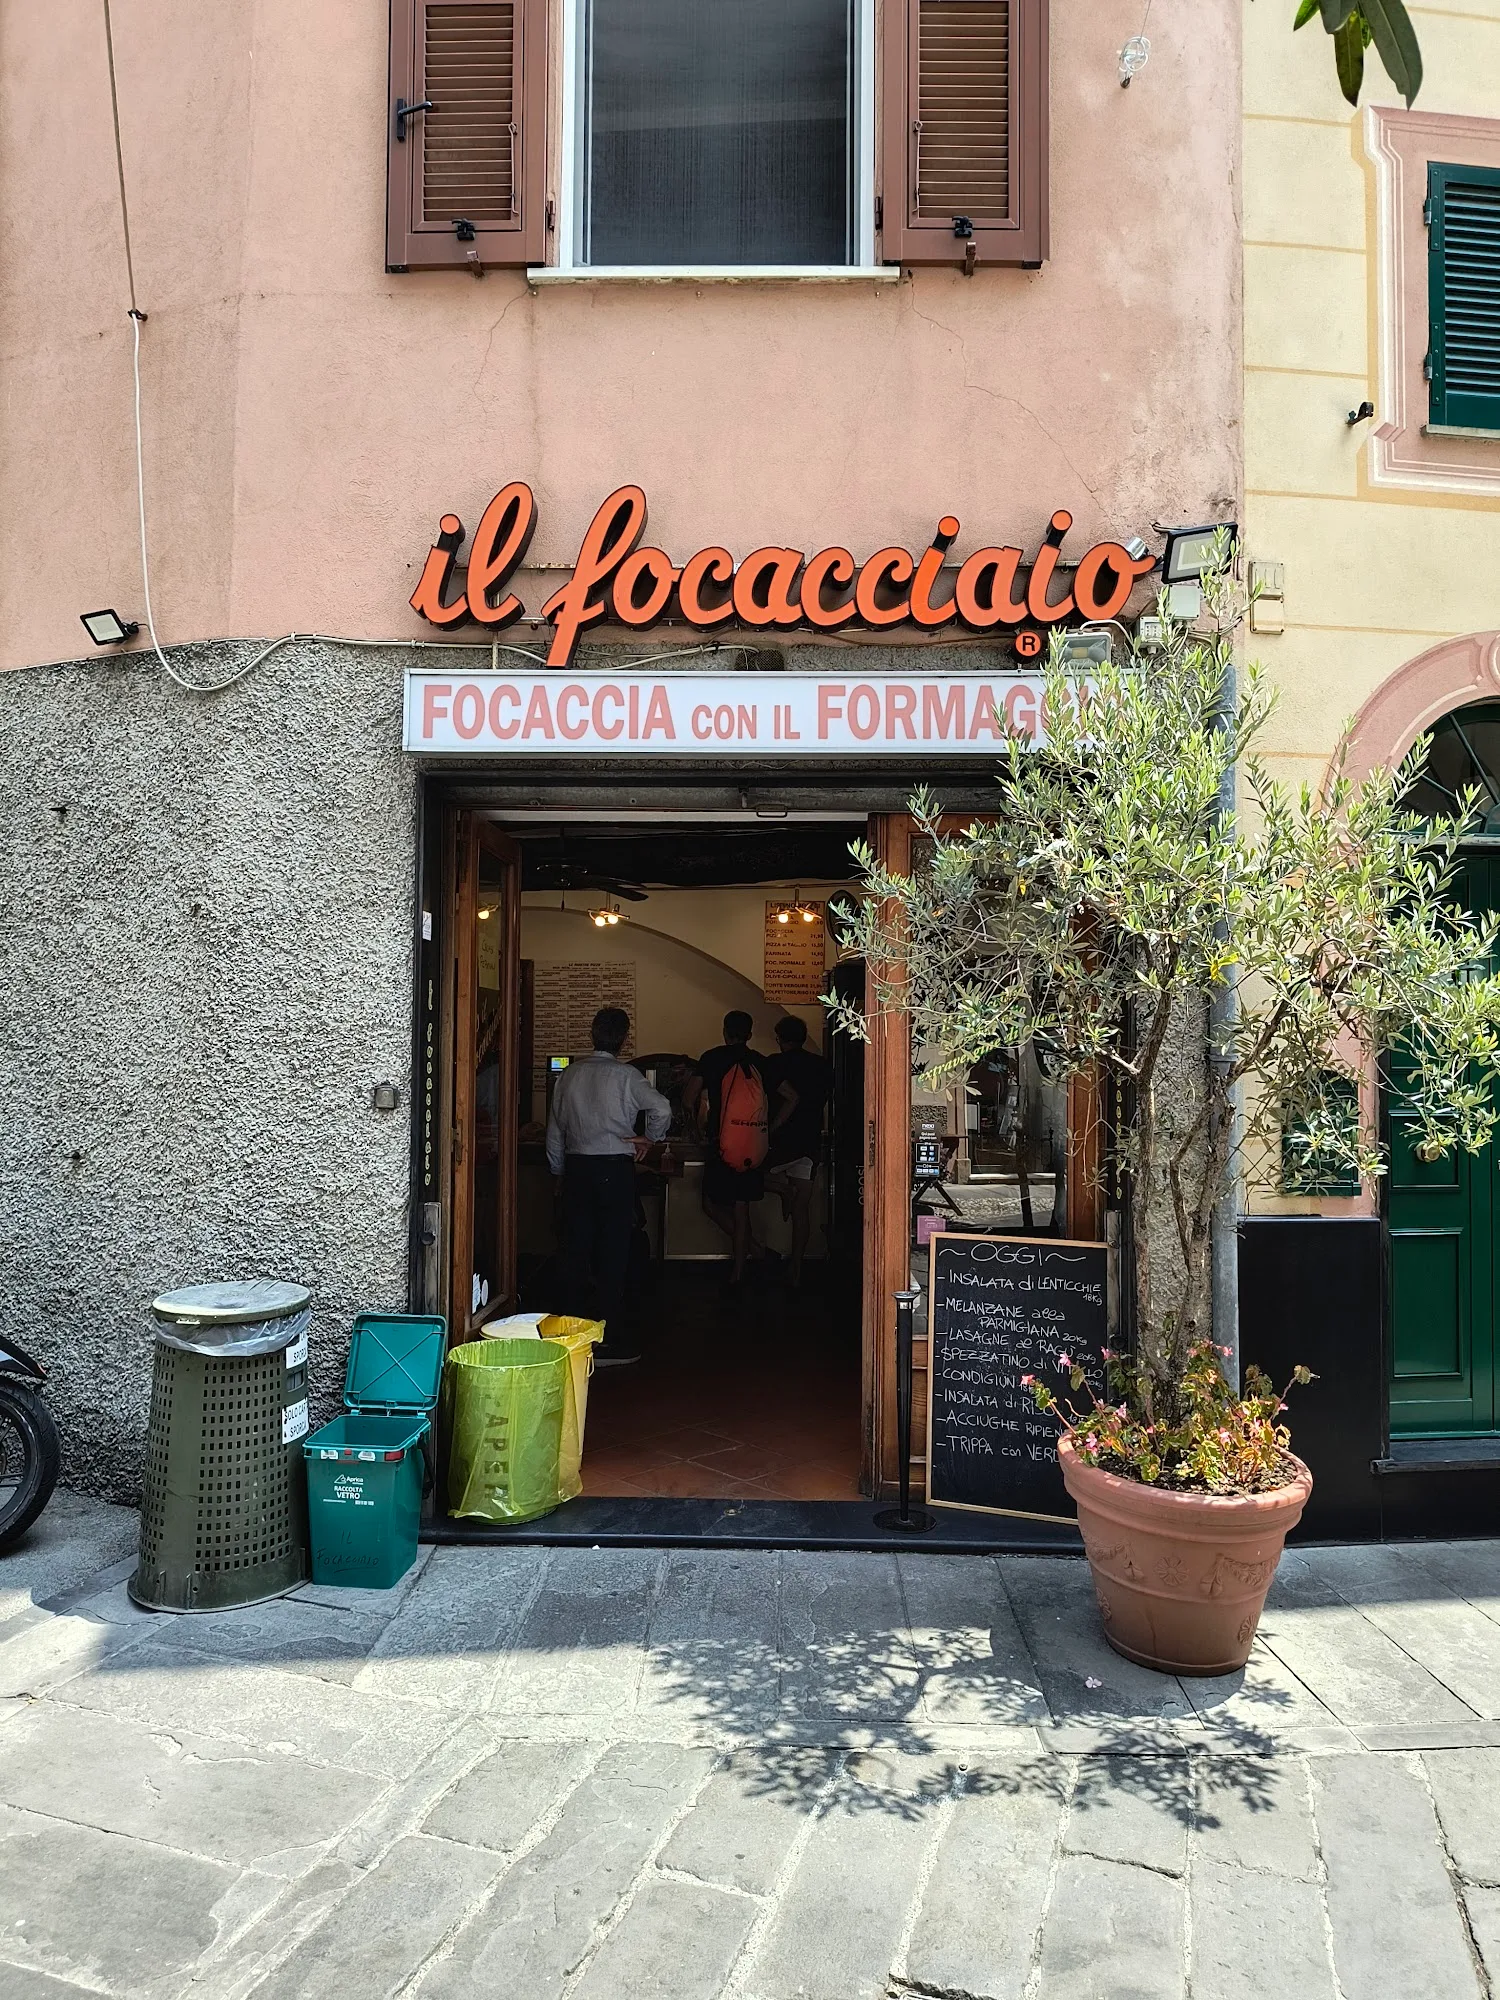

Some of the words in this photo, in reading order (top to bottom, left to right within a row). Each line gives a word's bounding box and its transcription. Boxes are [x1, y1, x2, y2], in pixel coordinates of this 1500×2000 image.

[410, 481, 536, 631] il
[541, 484, 1157, 668] focacciaio
[422, 684, 676, 740] FOCACCIA
[691, 704, 758, 740] CON
[774, 704, 801, 740] IL
[917, 1037, 1002, 1083] extravegine
[970, 1242, 1043, 1266] OGGI
[949, 1269, 1015, 1290] INSALATA
[1018, 1275, 1035, 1291] di
[1037, 1276, 1101, 1293] LENTICCHIE
[945, 1297, 1025, 1318] MELANZANE
[1031, 1307, 1066, 1321] alla
[949, 1328, 1010, 1346] LASAGNE
[977, 1316, 1060, 1339] PARMIGIANA
[940, 1347, 1030, 1369] SPEZZATINO
[1033, 1358, 1048, 1369] di
[1052, 1359, 1104, 1379] VITLO
[942, 1367, 1016, 1389] CONDIGIUN
[944, 1388, 998, 1409] INSALATA
[1005, 1394, 1017, 1408] di
[1021, 1397, 1056, 1417] RIO
[946, 1409, 1020, 1432] ACCIUGHE
[1025, 1422, 1063, 1438] RIPIEN
[946, 1435, 994, 1455] TRIPPA
[1001, 1447, 1022, 1457] con
[333, 1485, 363, 1493] RACCOLTA
[336, 1491, 361, 1500] VETRO
[341, 1529, 352, 1544] IL
